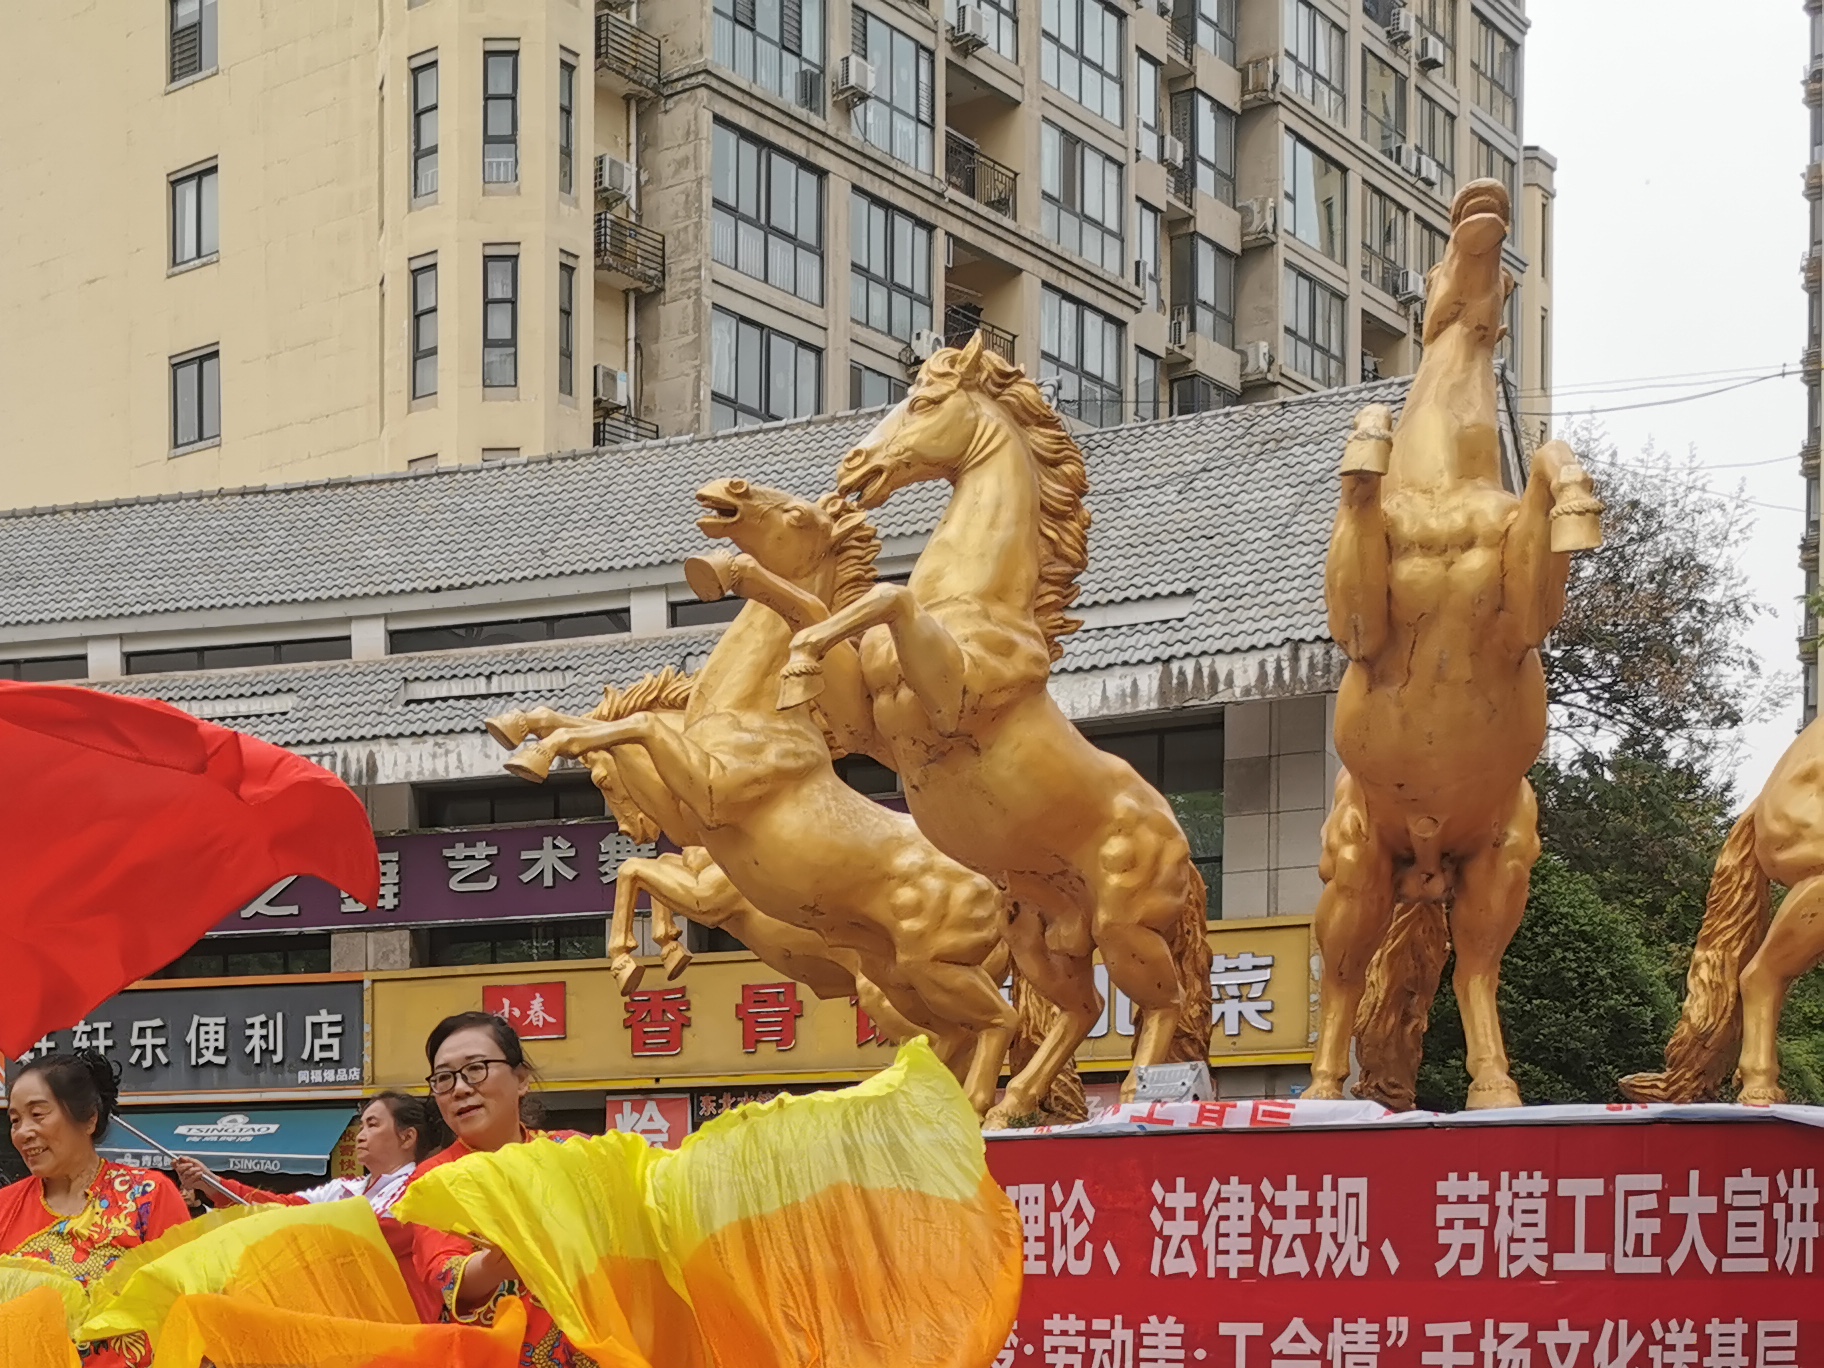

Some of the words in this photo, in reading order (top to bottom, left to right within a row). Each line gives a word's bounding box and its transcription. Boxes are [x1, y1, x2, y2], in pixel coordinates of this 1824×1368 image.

[623, 983, 903, 1057] 香骨
[185, 1126, 272, 1135] TSINGTAO
[228, 1157, 281, 1172] TSINGTAO
